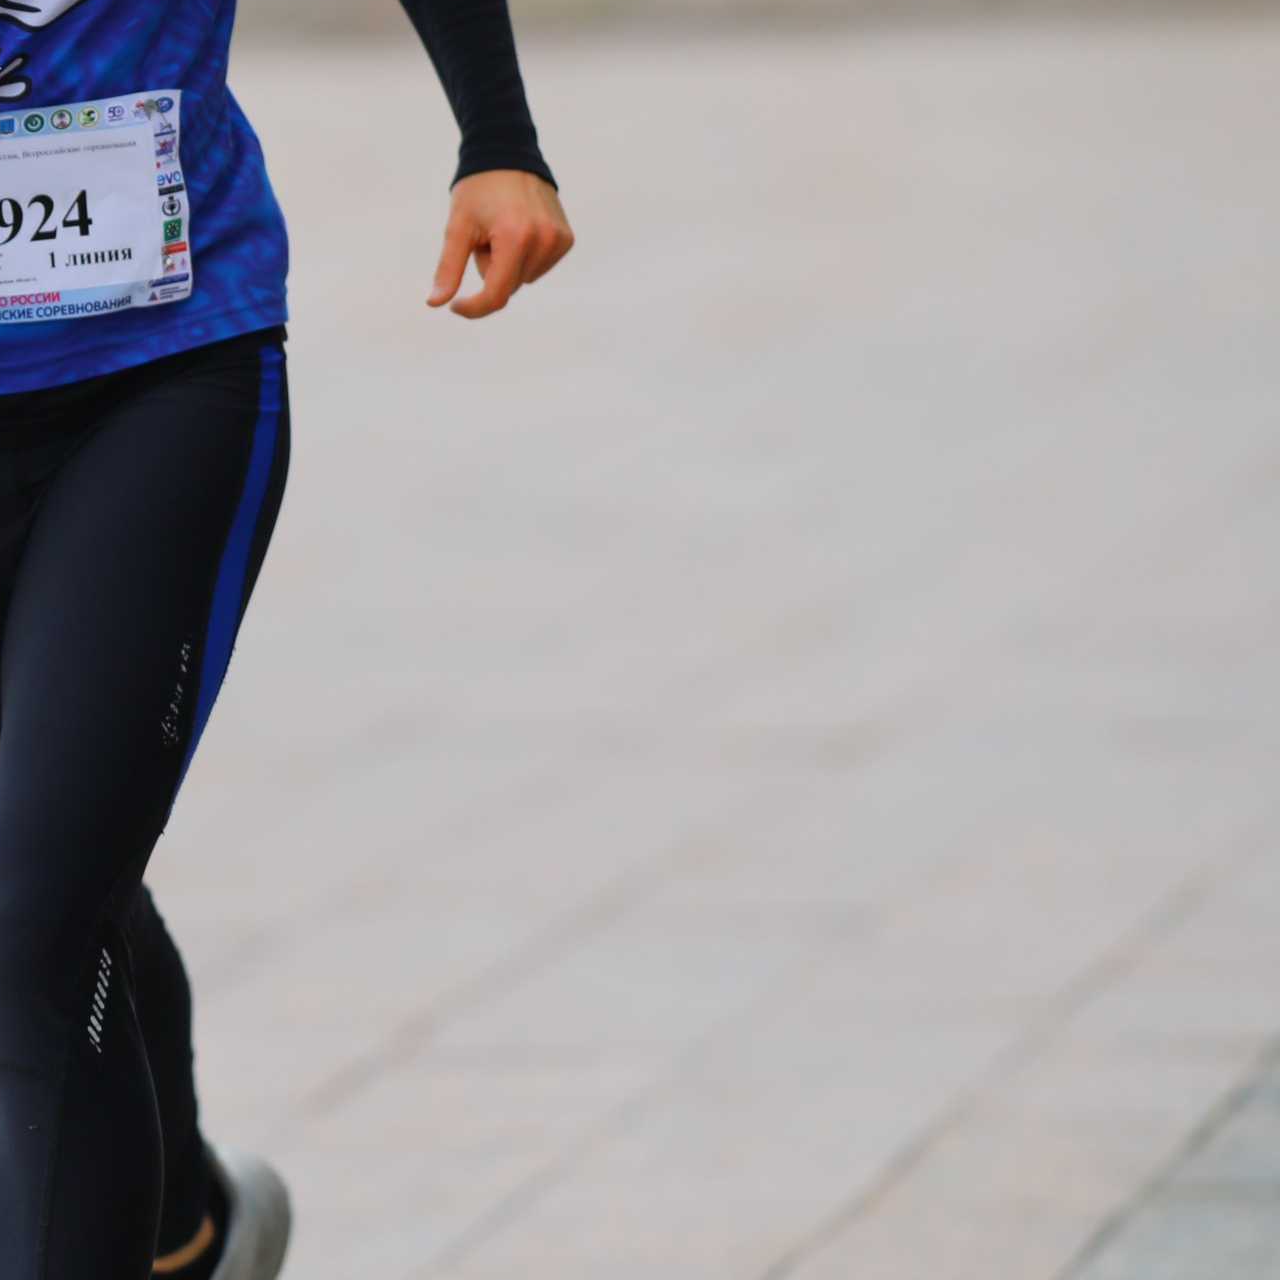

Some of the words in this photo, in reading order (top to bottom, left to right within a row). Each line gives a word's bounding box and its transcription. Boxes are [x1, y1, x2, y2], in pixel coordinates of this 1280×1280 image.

[157, 170, 181, 186] evo
[49, 251, 56, 268] 1
[65, 247, 132, 267] линия
[10, 291, 60, 306] РОССИИ
[36, 295, 132, 318] СОРЕВНОВАНИЯ
